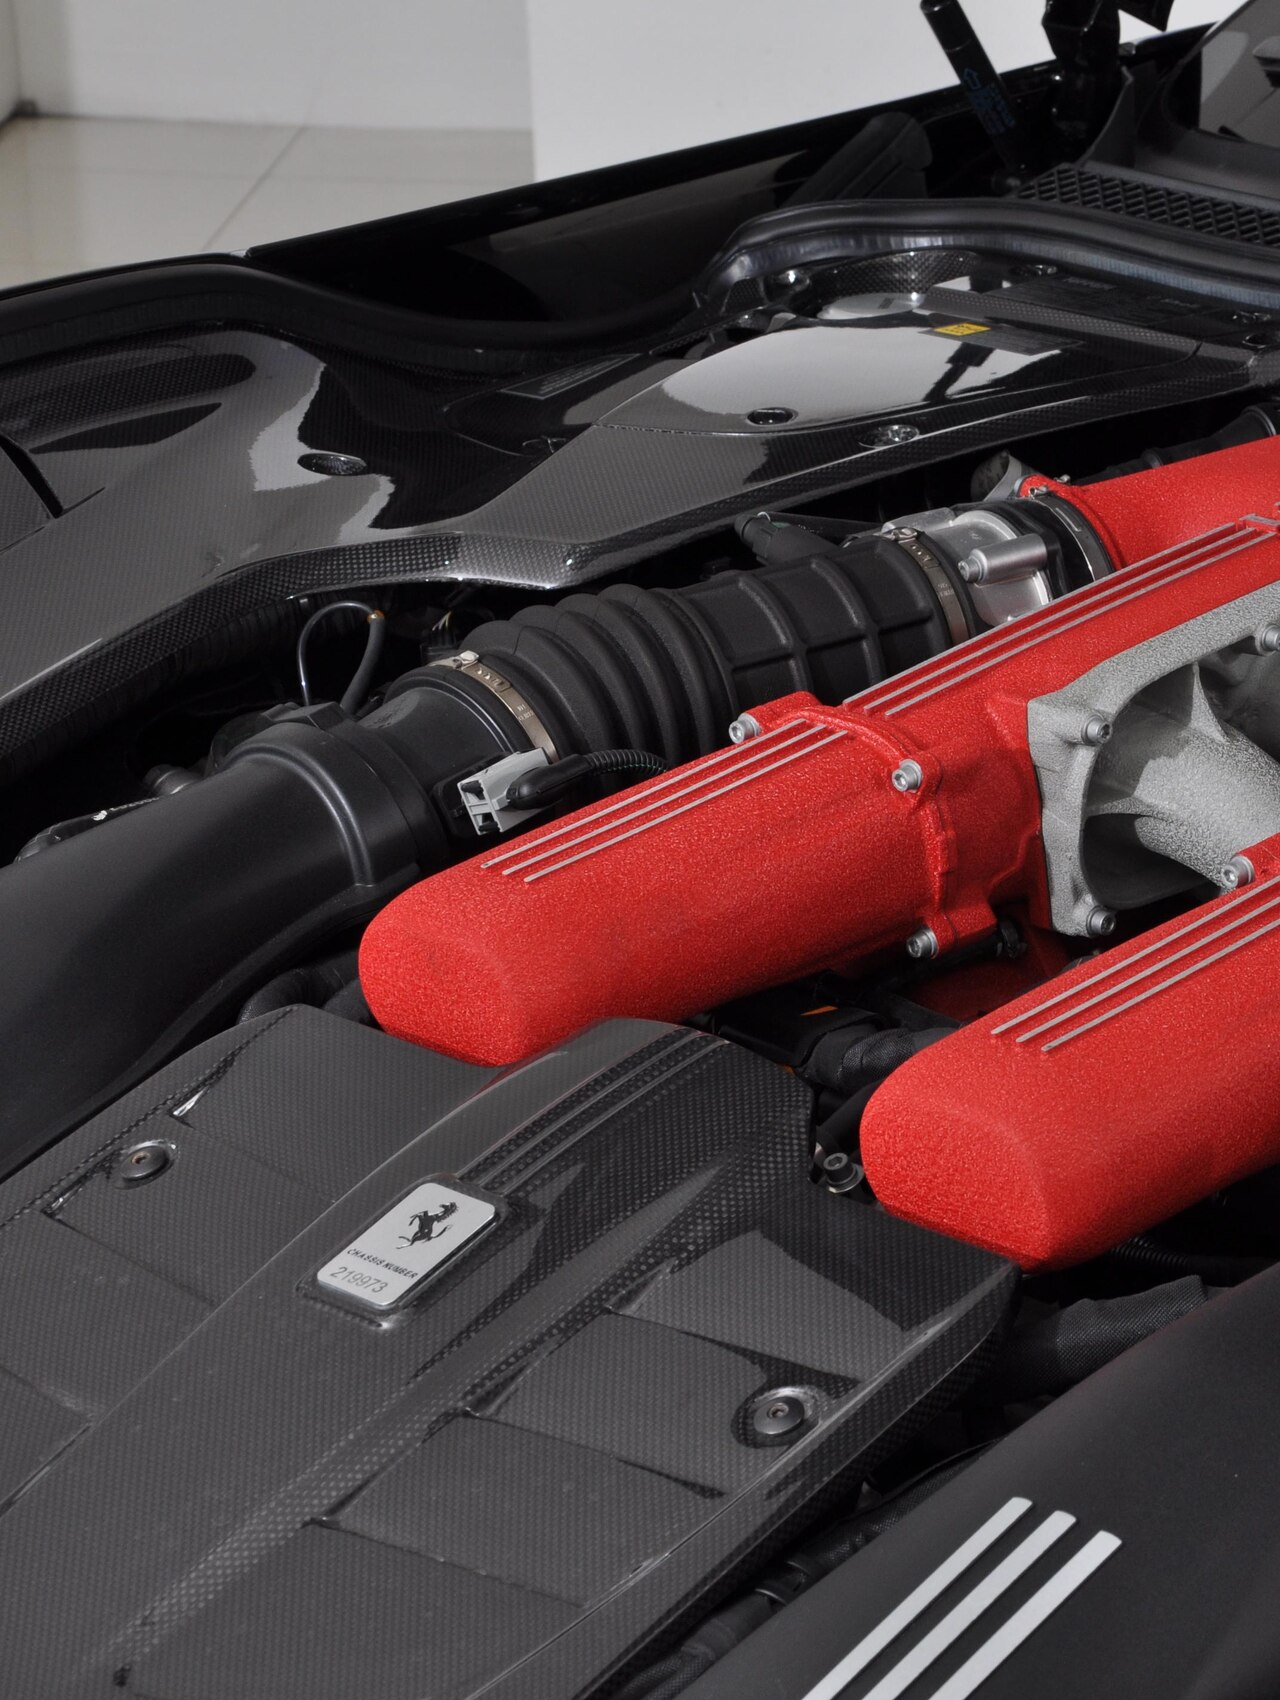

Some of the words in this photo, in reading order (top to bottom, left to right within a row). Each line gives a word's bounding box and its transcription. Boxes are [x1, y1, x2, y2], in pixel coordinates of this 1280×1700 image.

[347, 1248, 385, 1266] CHASSIS
[383, 1260, 419, 1279] NUMBER
[330, 1266, 389, 1293] 219973
